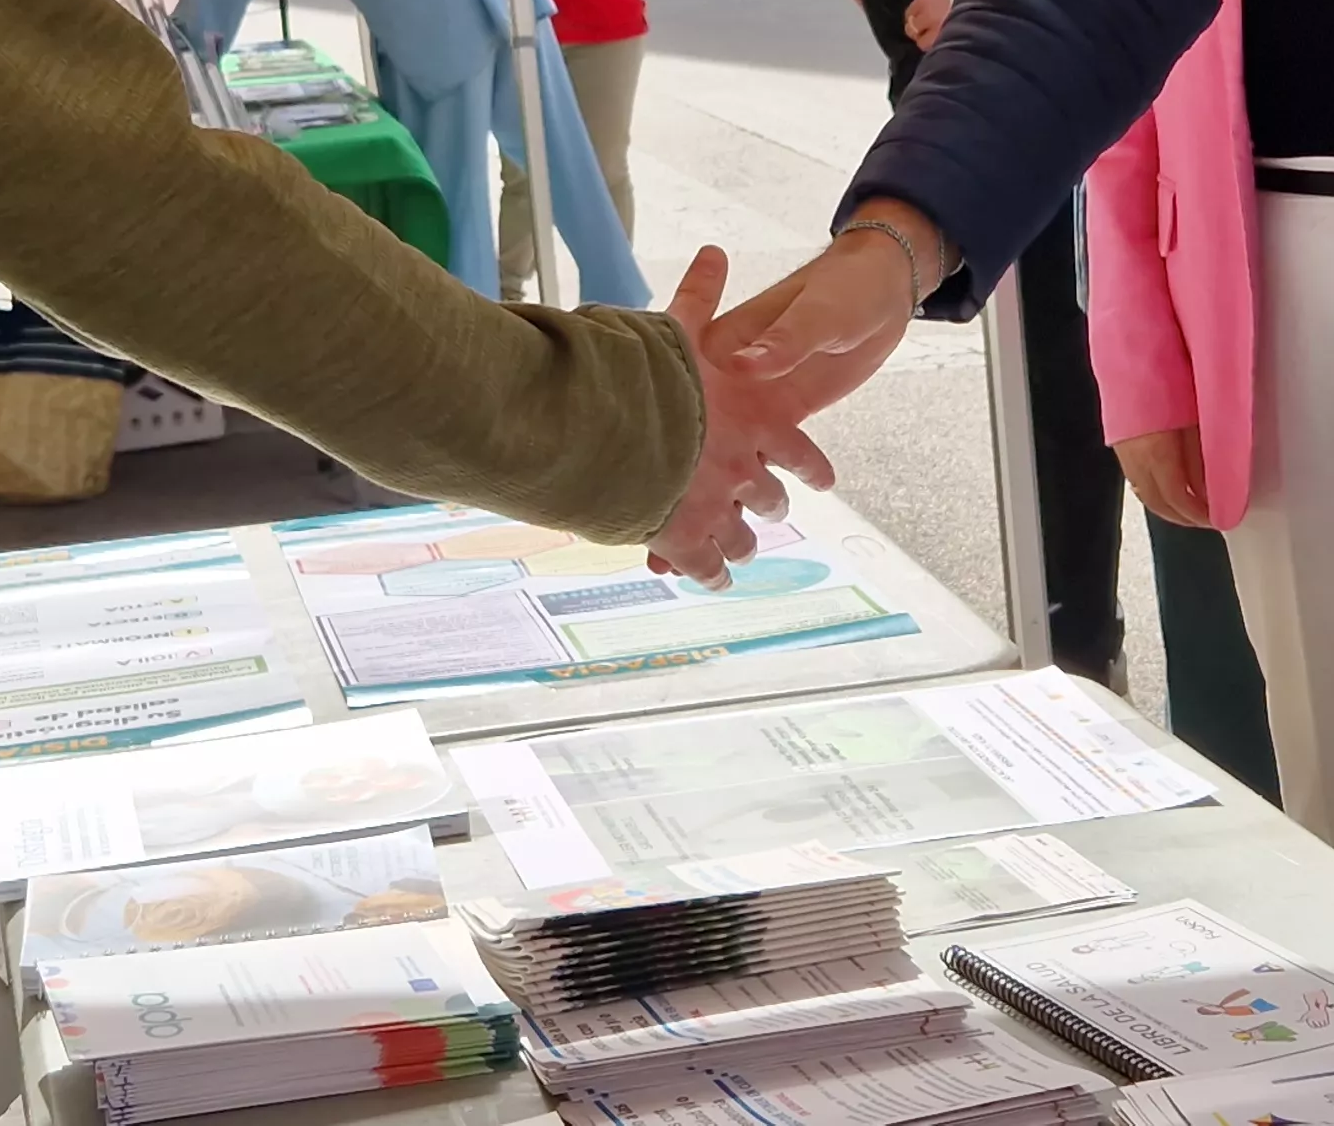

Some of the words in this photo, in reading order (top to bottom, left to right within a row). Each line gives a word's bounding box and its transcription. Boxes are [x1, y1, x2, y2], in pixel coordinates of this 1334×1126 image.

[545, 645, 731, 680] DISFAGIA
[75, 696, 180, 718] calidad
[146, 709, 182, 721] Su
[32, 711, 69, 723] de
[1021, 960, 1088, 994] SALUD
[1077, 993, 1113, 1008] LA
[1100, 1007, 1139, 1024] DE
[1126, 1022, 1194, 1055] LIBRO
